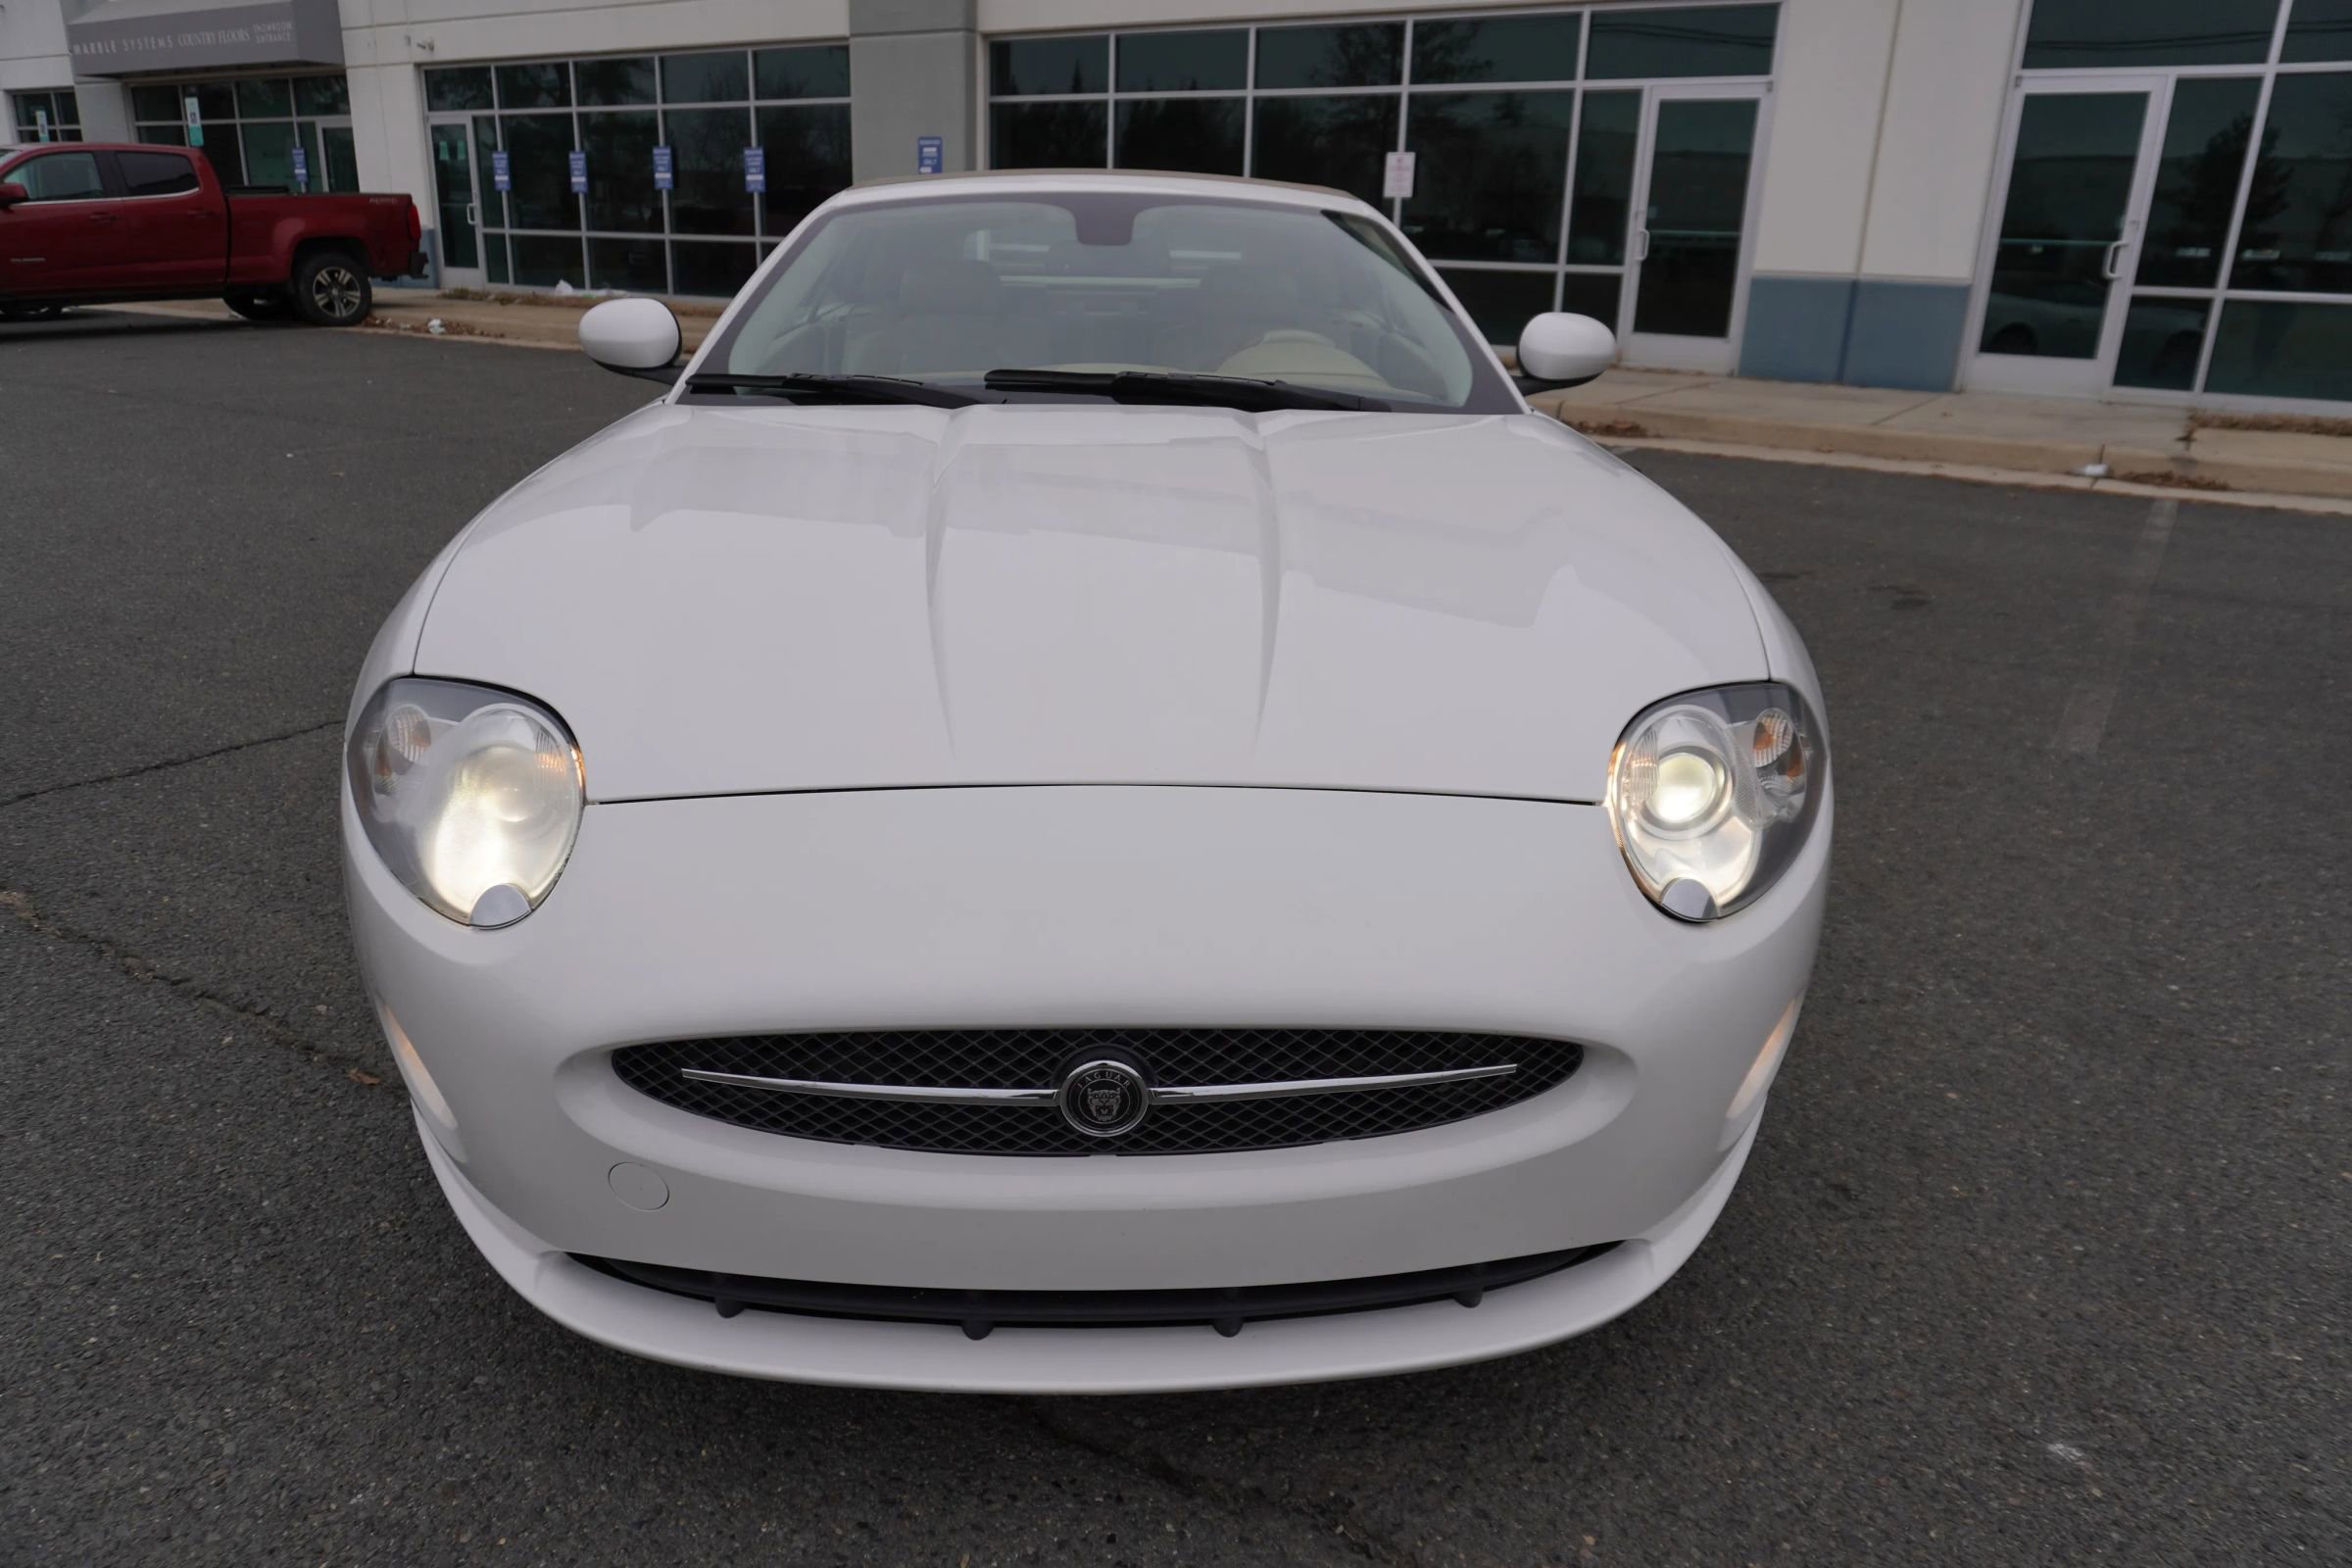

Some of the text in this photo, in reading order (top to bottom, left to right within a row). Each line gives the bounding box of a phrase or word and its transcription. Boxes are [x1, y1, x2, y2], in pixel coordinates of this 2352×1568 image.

[73, 35, 172, 55] MARBLE SYSTEMS
[177, 28, 251, 48] COUNTRY FLOORS
[256, 32, 291, 44] ENTRANCE
[1076, 1071, 1131, 1089] JAGUAR
